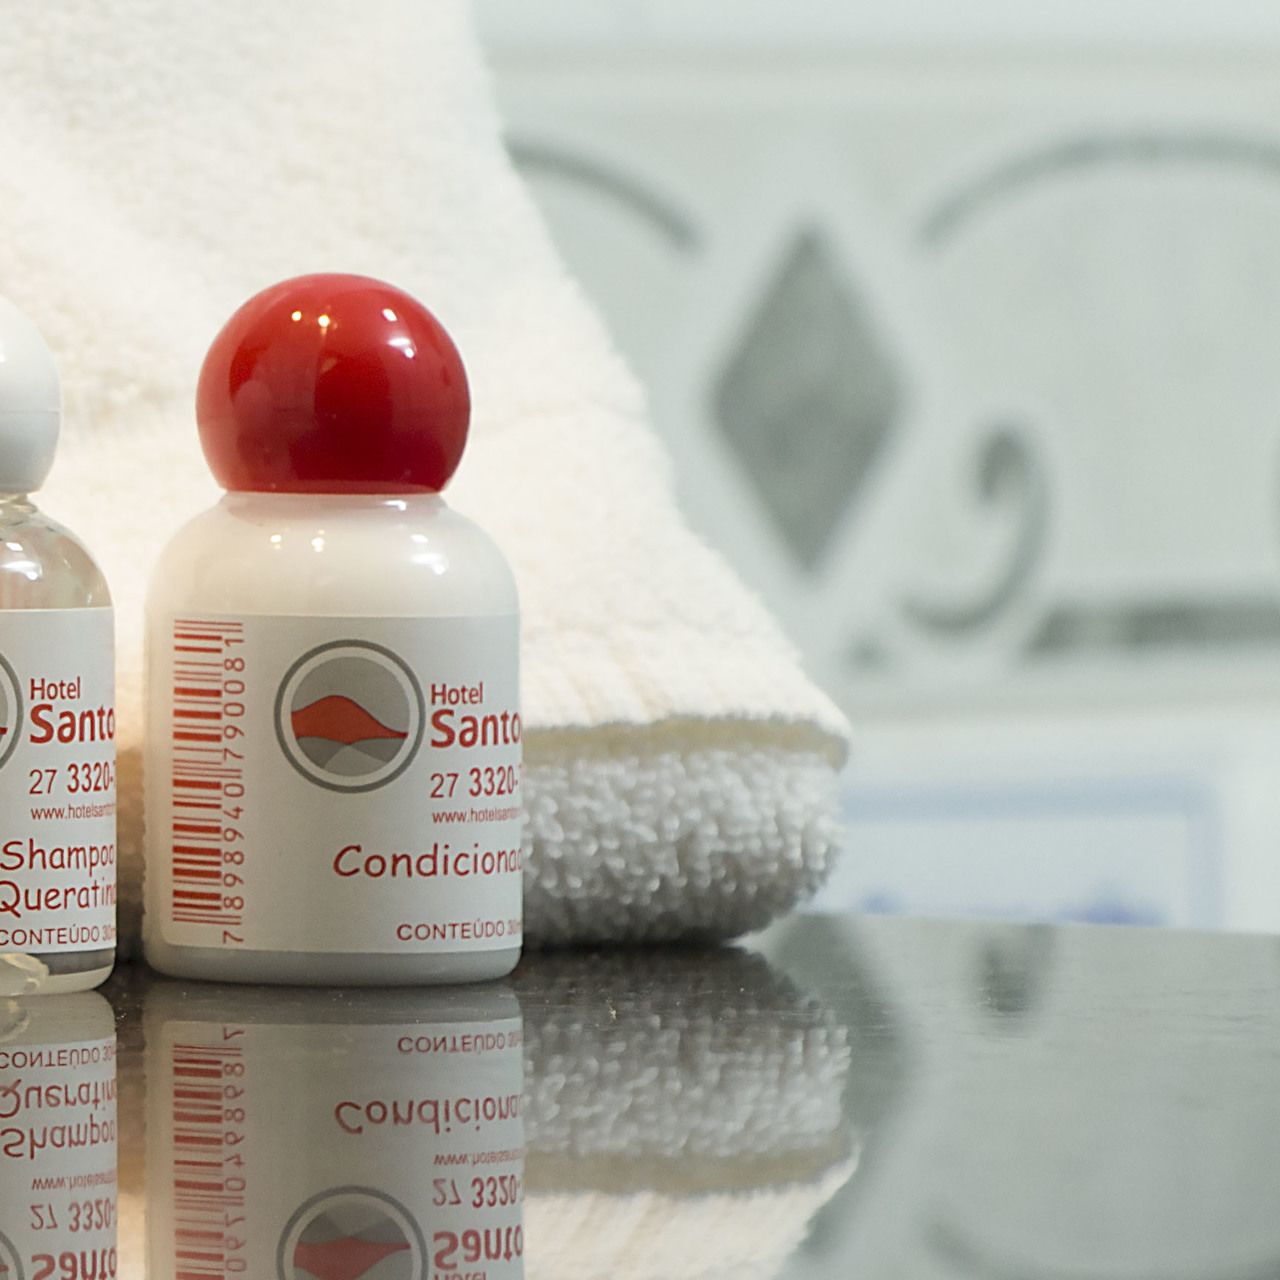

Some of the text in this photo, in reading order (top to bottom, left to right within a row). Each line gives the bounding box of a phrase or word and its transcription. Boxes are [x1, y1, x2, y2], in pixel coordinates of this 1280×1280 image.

[29, 676, 82, 701] Hotel
[430, 681, 484, 706] Hotel
[29, 703, 116, 745] Santo
[430, 708, 522, 749] Santo
[28, 760, 116, 795] 27 3320-
[429, 764, 521, 799] 27 3320-
[396, 918, 505, 941] CONTEÚDO
